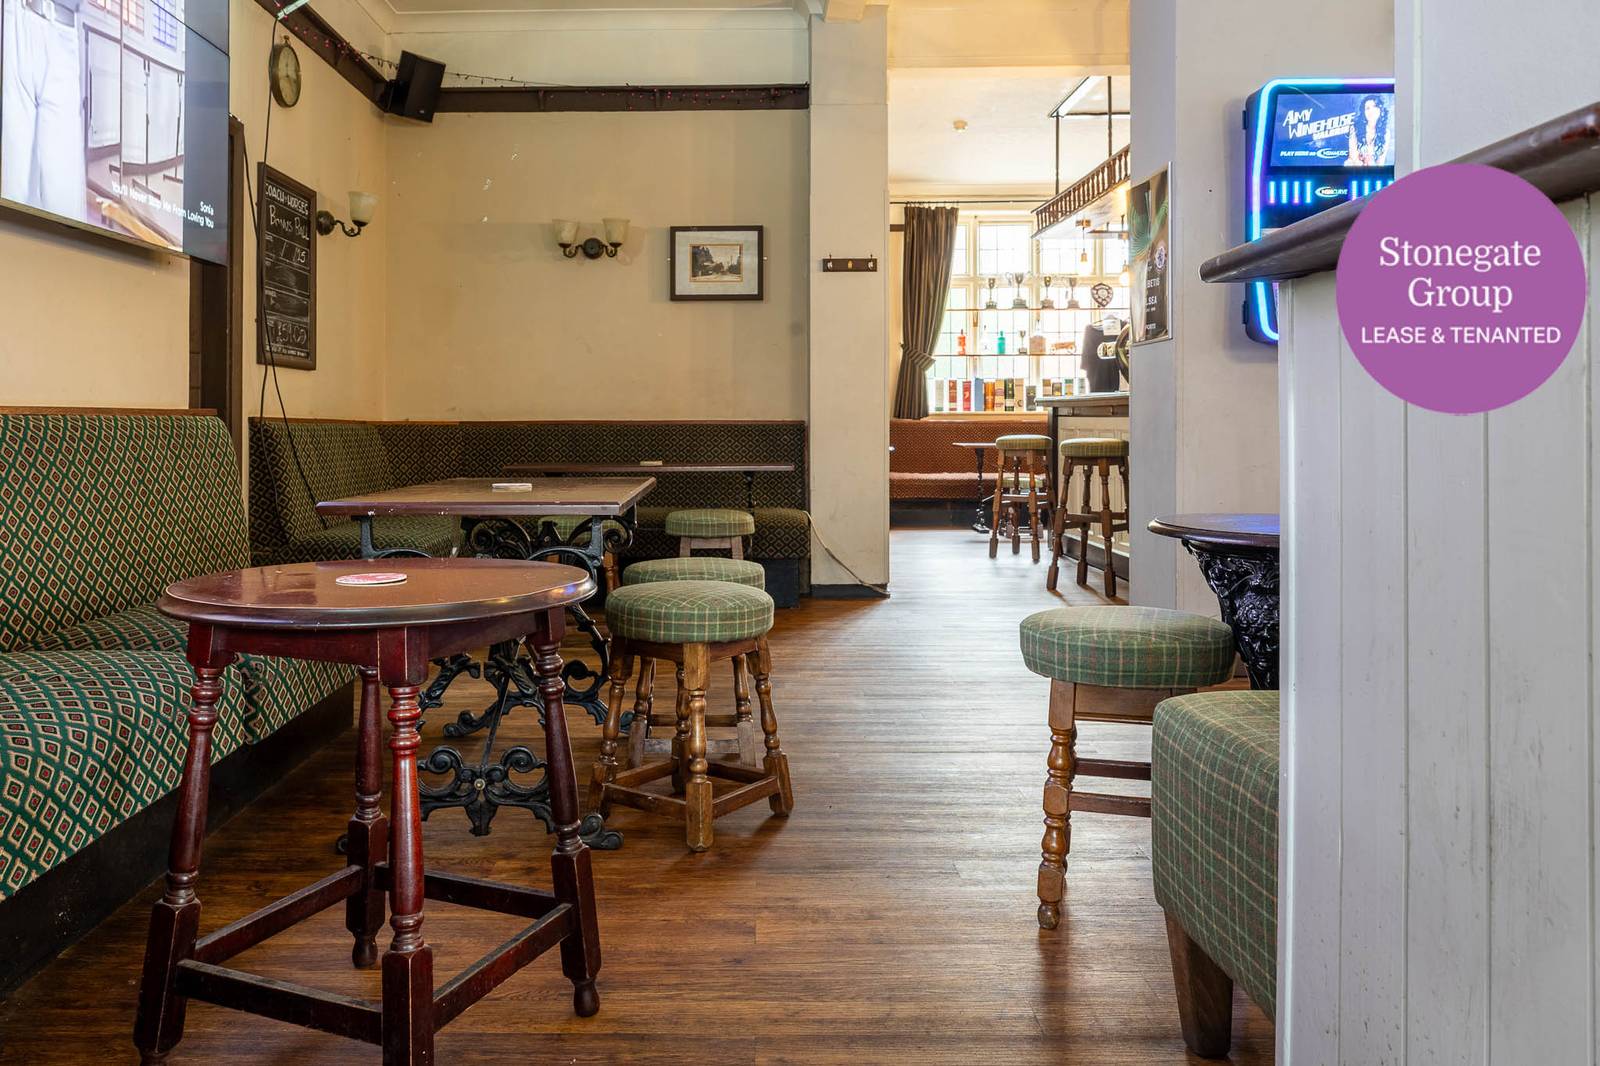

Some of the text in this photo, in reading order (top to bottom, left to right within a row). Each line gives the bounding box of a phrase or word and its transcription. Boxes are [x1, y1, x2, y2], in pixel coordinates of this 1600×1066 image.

[1283, 108, 1312, 127] AMY
[1288, 112, 1356, 139] WINEHOUSE
[200, 201, 214, 216] Sonia
[187, 209, 205, 227] Loving
[205, 216, 214, 229] You
